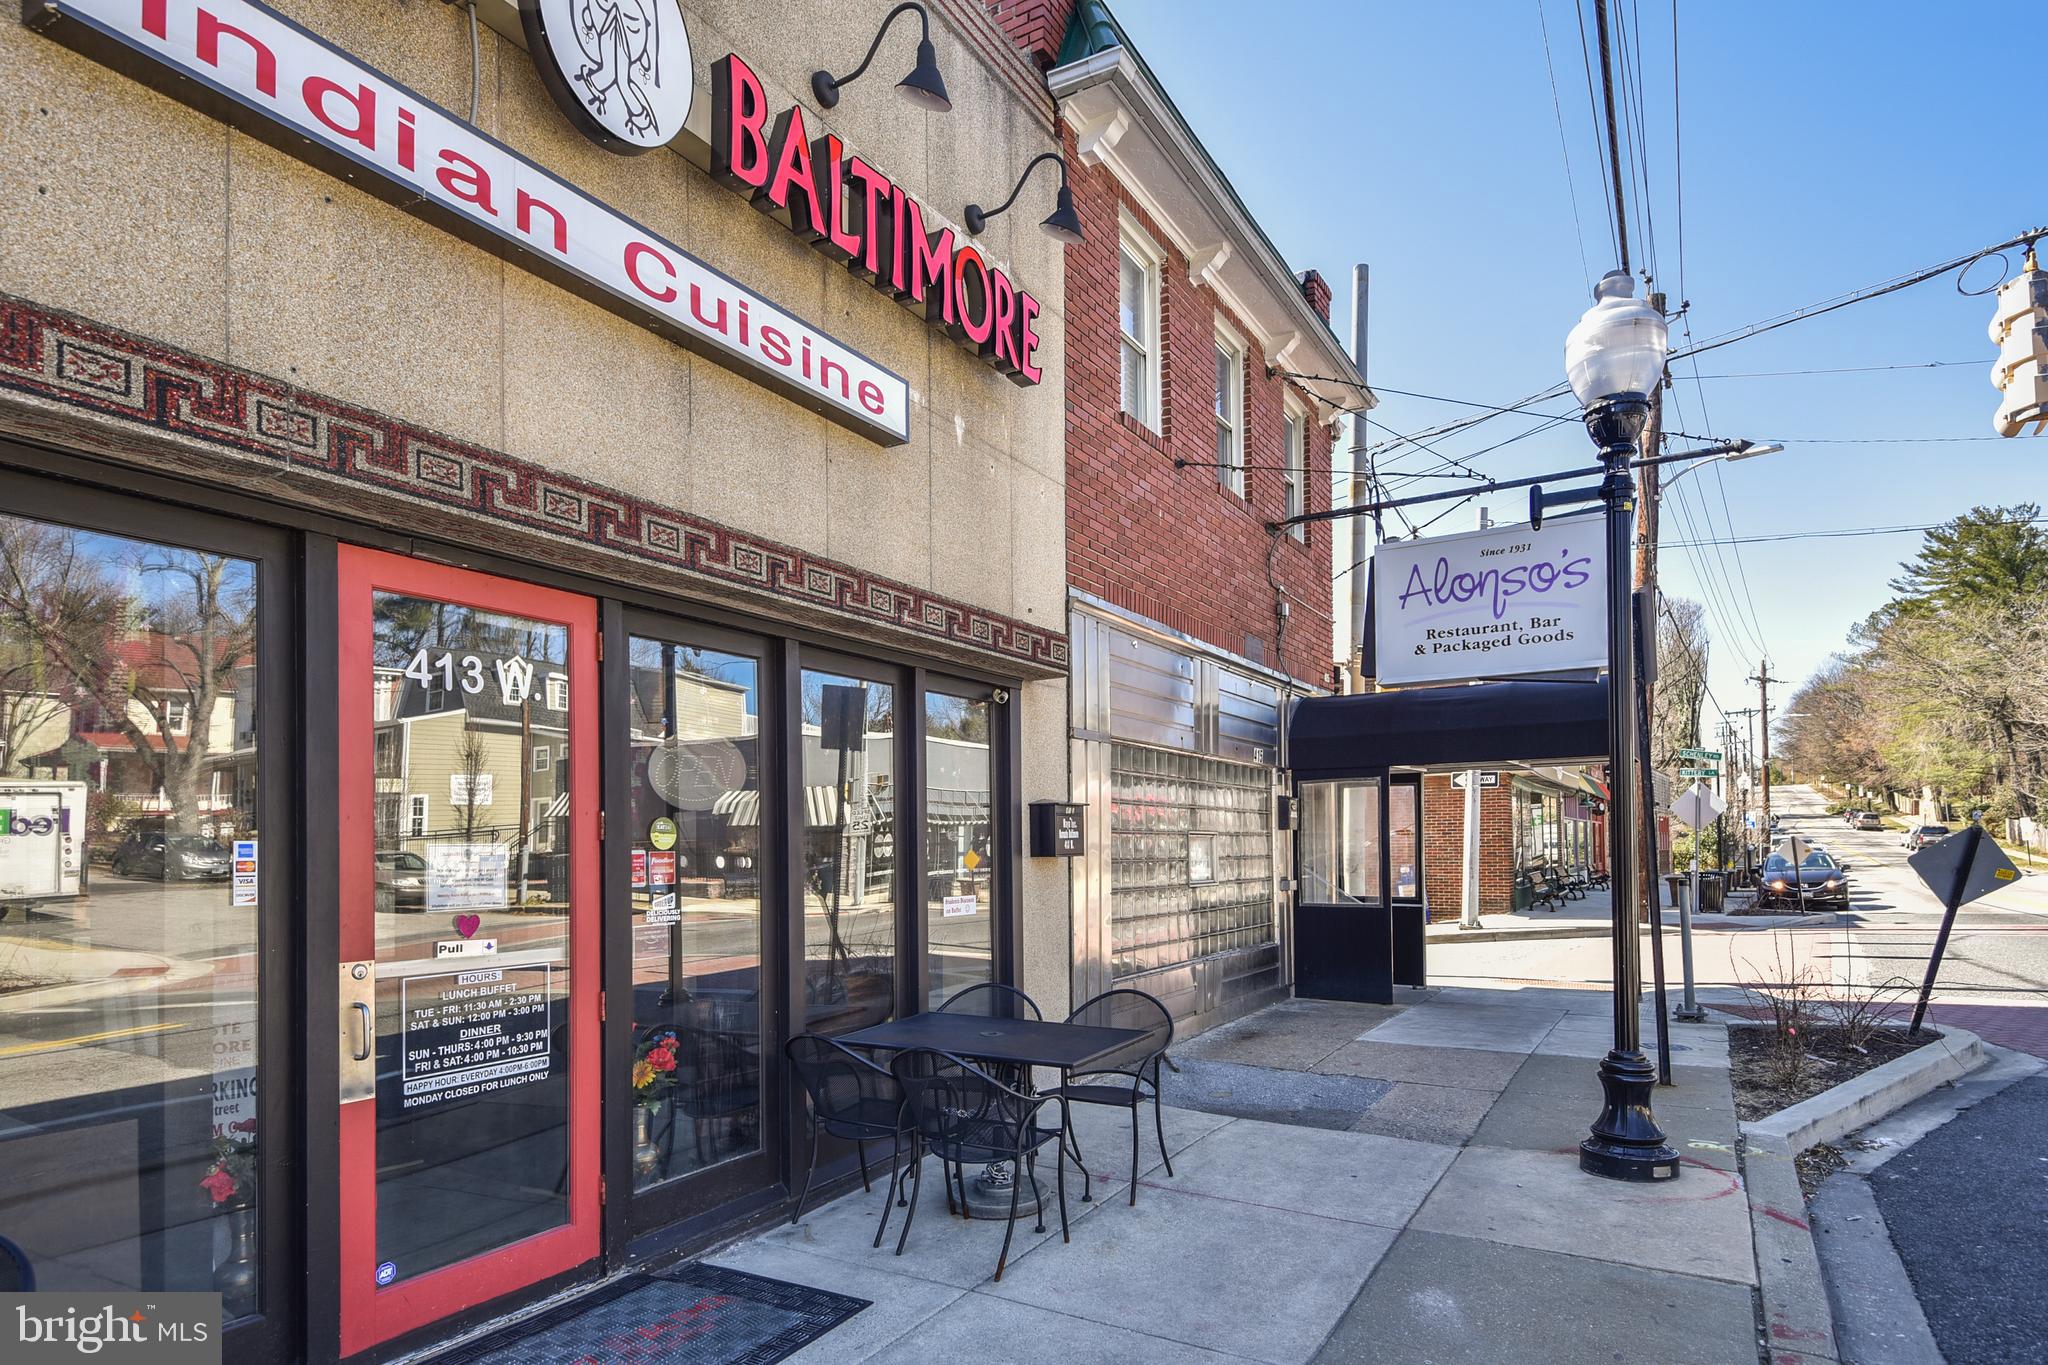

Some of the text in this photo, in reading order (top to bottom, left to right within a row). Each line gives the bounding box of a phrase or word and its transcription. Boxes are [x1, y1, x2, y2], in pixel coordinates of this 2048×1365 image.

[728, 52, 1044, 387] BALTIMORE
[623, 241, 886, 417] Cuisine
[1479, 542, 1532, 558] Since 1931
[1398, 548, 1592, 620] Alonso's
[1414, 628, 1574, 656] & Packaged Goods
[1426, 616, 1561, 641] Restaurant, Bar
[405, 649, 542, 700] 413 W.
[646, 915, 681, 923] DELIVERING
[438, 944, 464, 955] Pull
[443, 983, 517, 1001] LUNCH BUFFET
[410, 1020, 429, 1031] SAT
[432, 1018, 440, 1028] &
[442, 1015, 465, 1027] SUN:
[467, 1012, 491, 1023] 12:00
[493, 1009, 506, 1018] PM
[513, 1006, 530, 1016] 3:00
[531, 1003, 545, 1013] PM
[414, 1008, 434, 1019] TUE
[443, 1005, 461, 1015] FRI:
[463, 1001, 486, 1012] 11:30
[488, 999, 502, 1009] AM
[509, 995, 527, 1005] 2:30
[529, 994, 541, 1002] PM
[408, 1048, 430, 1061] SUN
[438, 1041, 474, 1056] THURS:
[474, 1037, 494, 1050] 4:00
[496, 1035, 510, 1046] PM
[516, 1031, 534, 1043] 9:30
[535, 1029, 548, 1039] PM
[460, 1024, 502, 1038] DINNER
[414, 1061, 431, 1073] FRI
[433, 1060, 441, 1069] &
[443, 1056, 463, 1068] SAT:
[463, 1052, 484, 1064] 4:00
[486, 1049, 500, 1060] PM
[507, 1043, 529, 1055] 10:30
[530, 1041, 543, 1051] PM
[404, 1070, 549, 1108] MONDAY CLOSED FOR LUNCH ONLY
[406, 1080, 433, 1093] HAPPY
[460, 1068, 498, 1083] EVERYDAY
